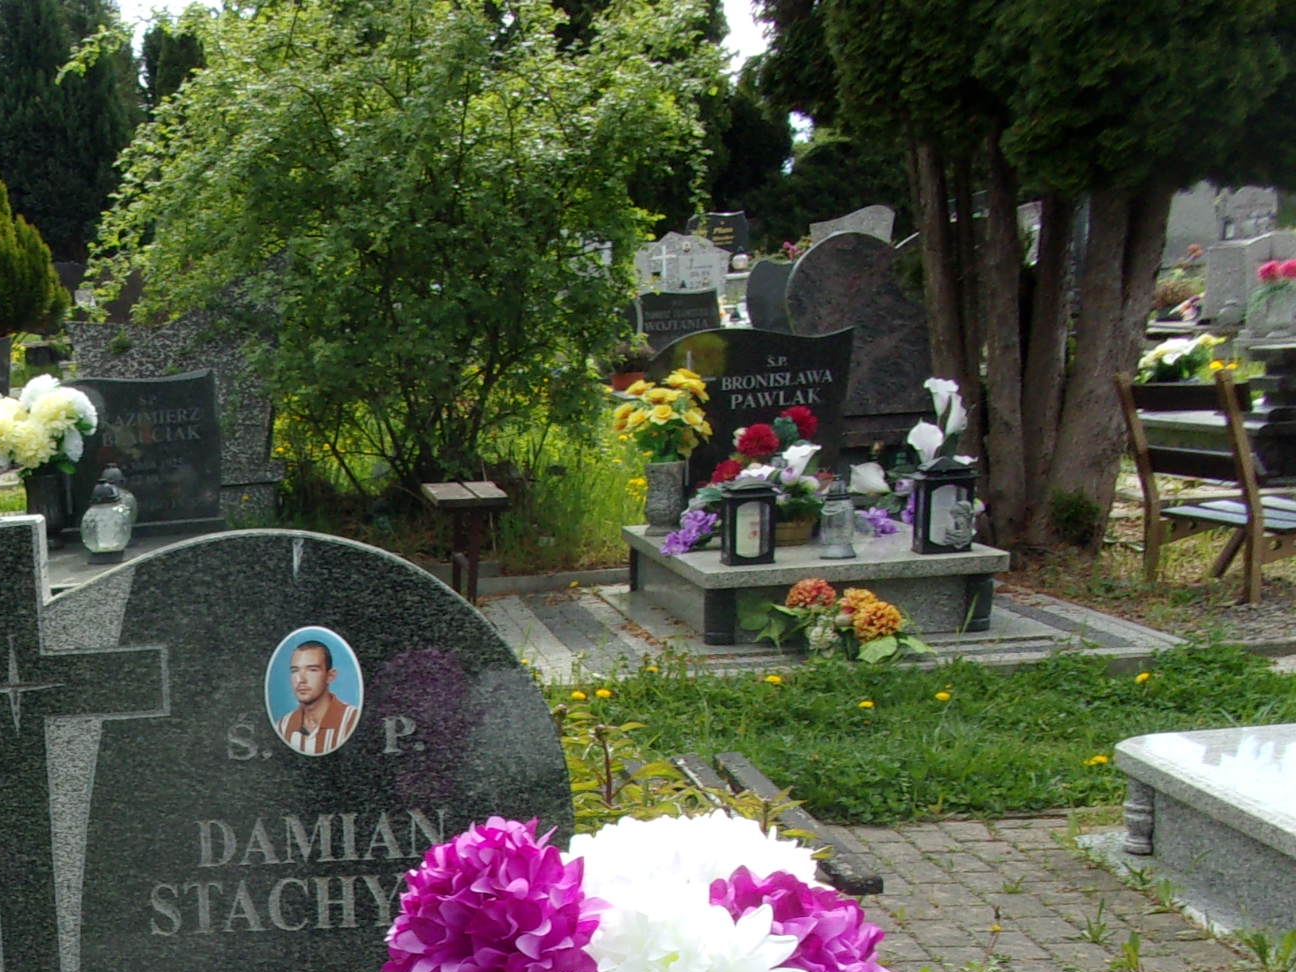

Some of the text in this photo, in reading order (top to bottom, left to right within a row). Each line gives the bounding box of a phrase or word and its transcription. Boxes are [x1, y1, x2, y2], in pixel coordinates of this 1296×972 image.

[720, 369, 833, 391] BRONISŁAWA
[730, 388, 821, 409] PAWLAK
[381, 715, 427, 755] P.
[195, 808, 446, 868] DAMIAN
[149, 872, 407, 937] STACHY
